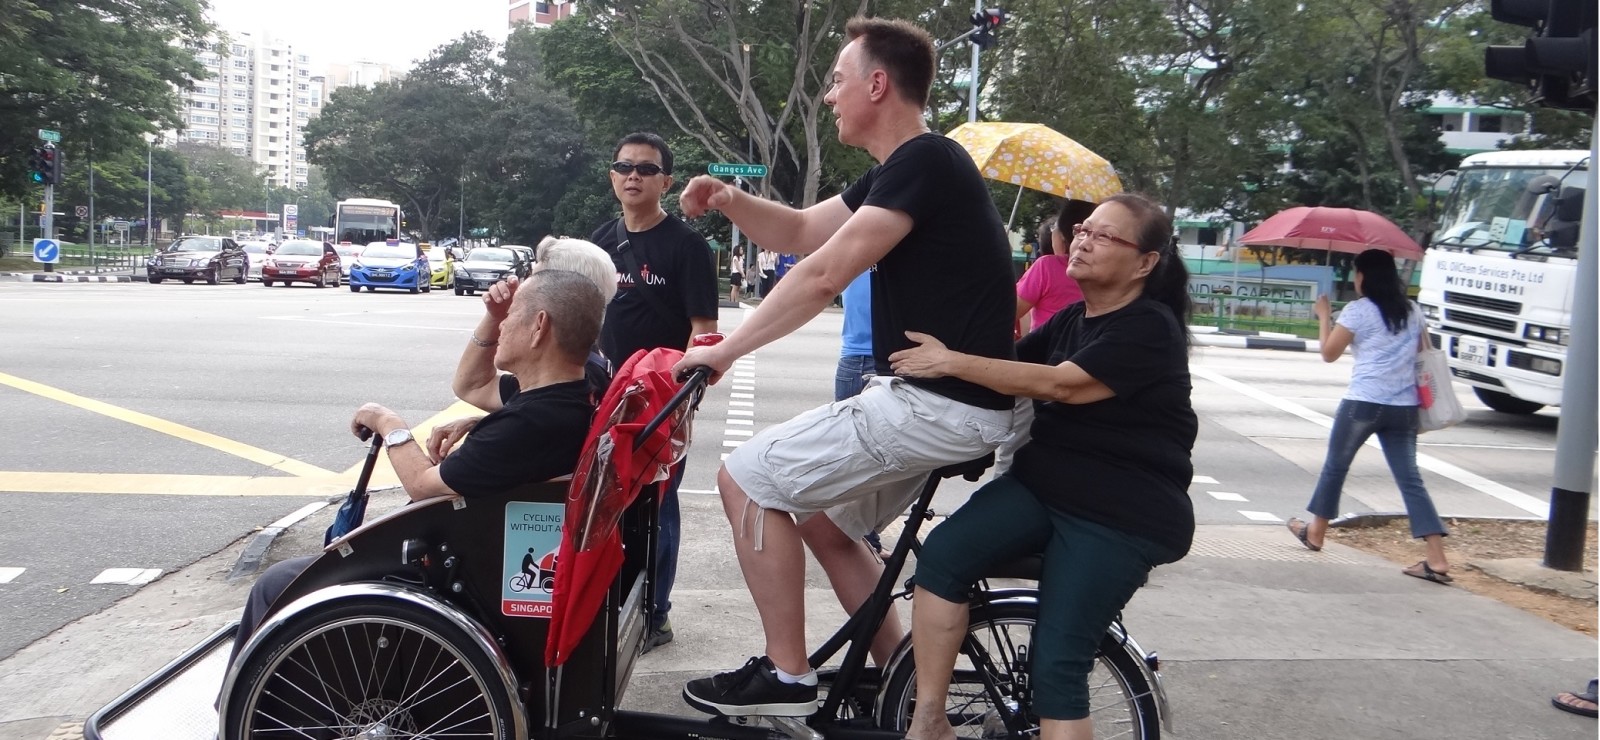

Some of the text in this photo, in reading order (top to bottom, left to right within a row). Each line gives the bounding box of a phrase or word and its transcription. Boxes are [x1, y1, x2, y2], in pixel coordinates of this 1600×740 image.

[713, 164, 763, 175] Ganges Ave
[1478, 264, 1509, 279] Services
[1511, 269, 1526, 282] Pte
[1528, 272, 1544, 284] Ltd
[1446, 276, 1523, 295] MITSUBISHI
[1236, 285, 1306, 304] GARDEN
[523, 513, 560, 523] CYCLING
[510, 523, 553, 533] WITHOUT
[510, 603, 553, 615] SINGAPO
